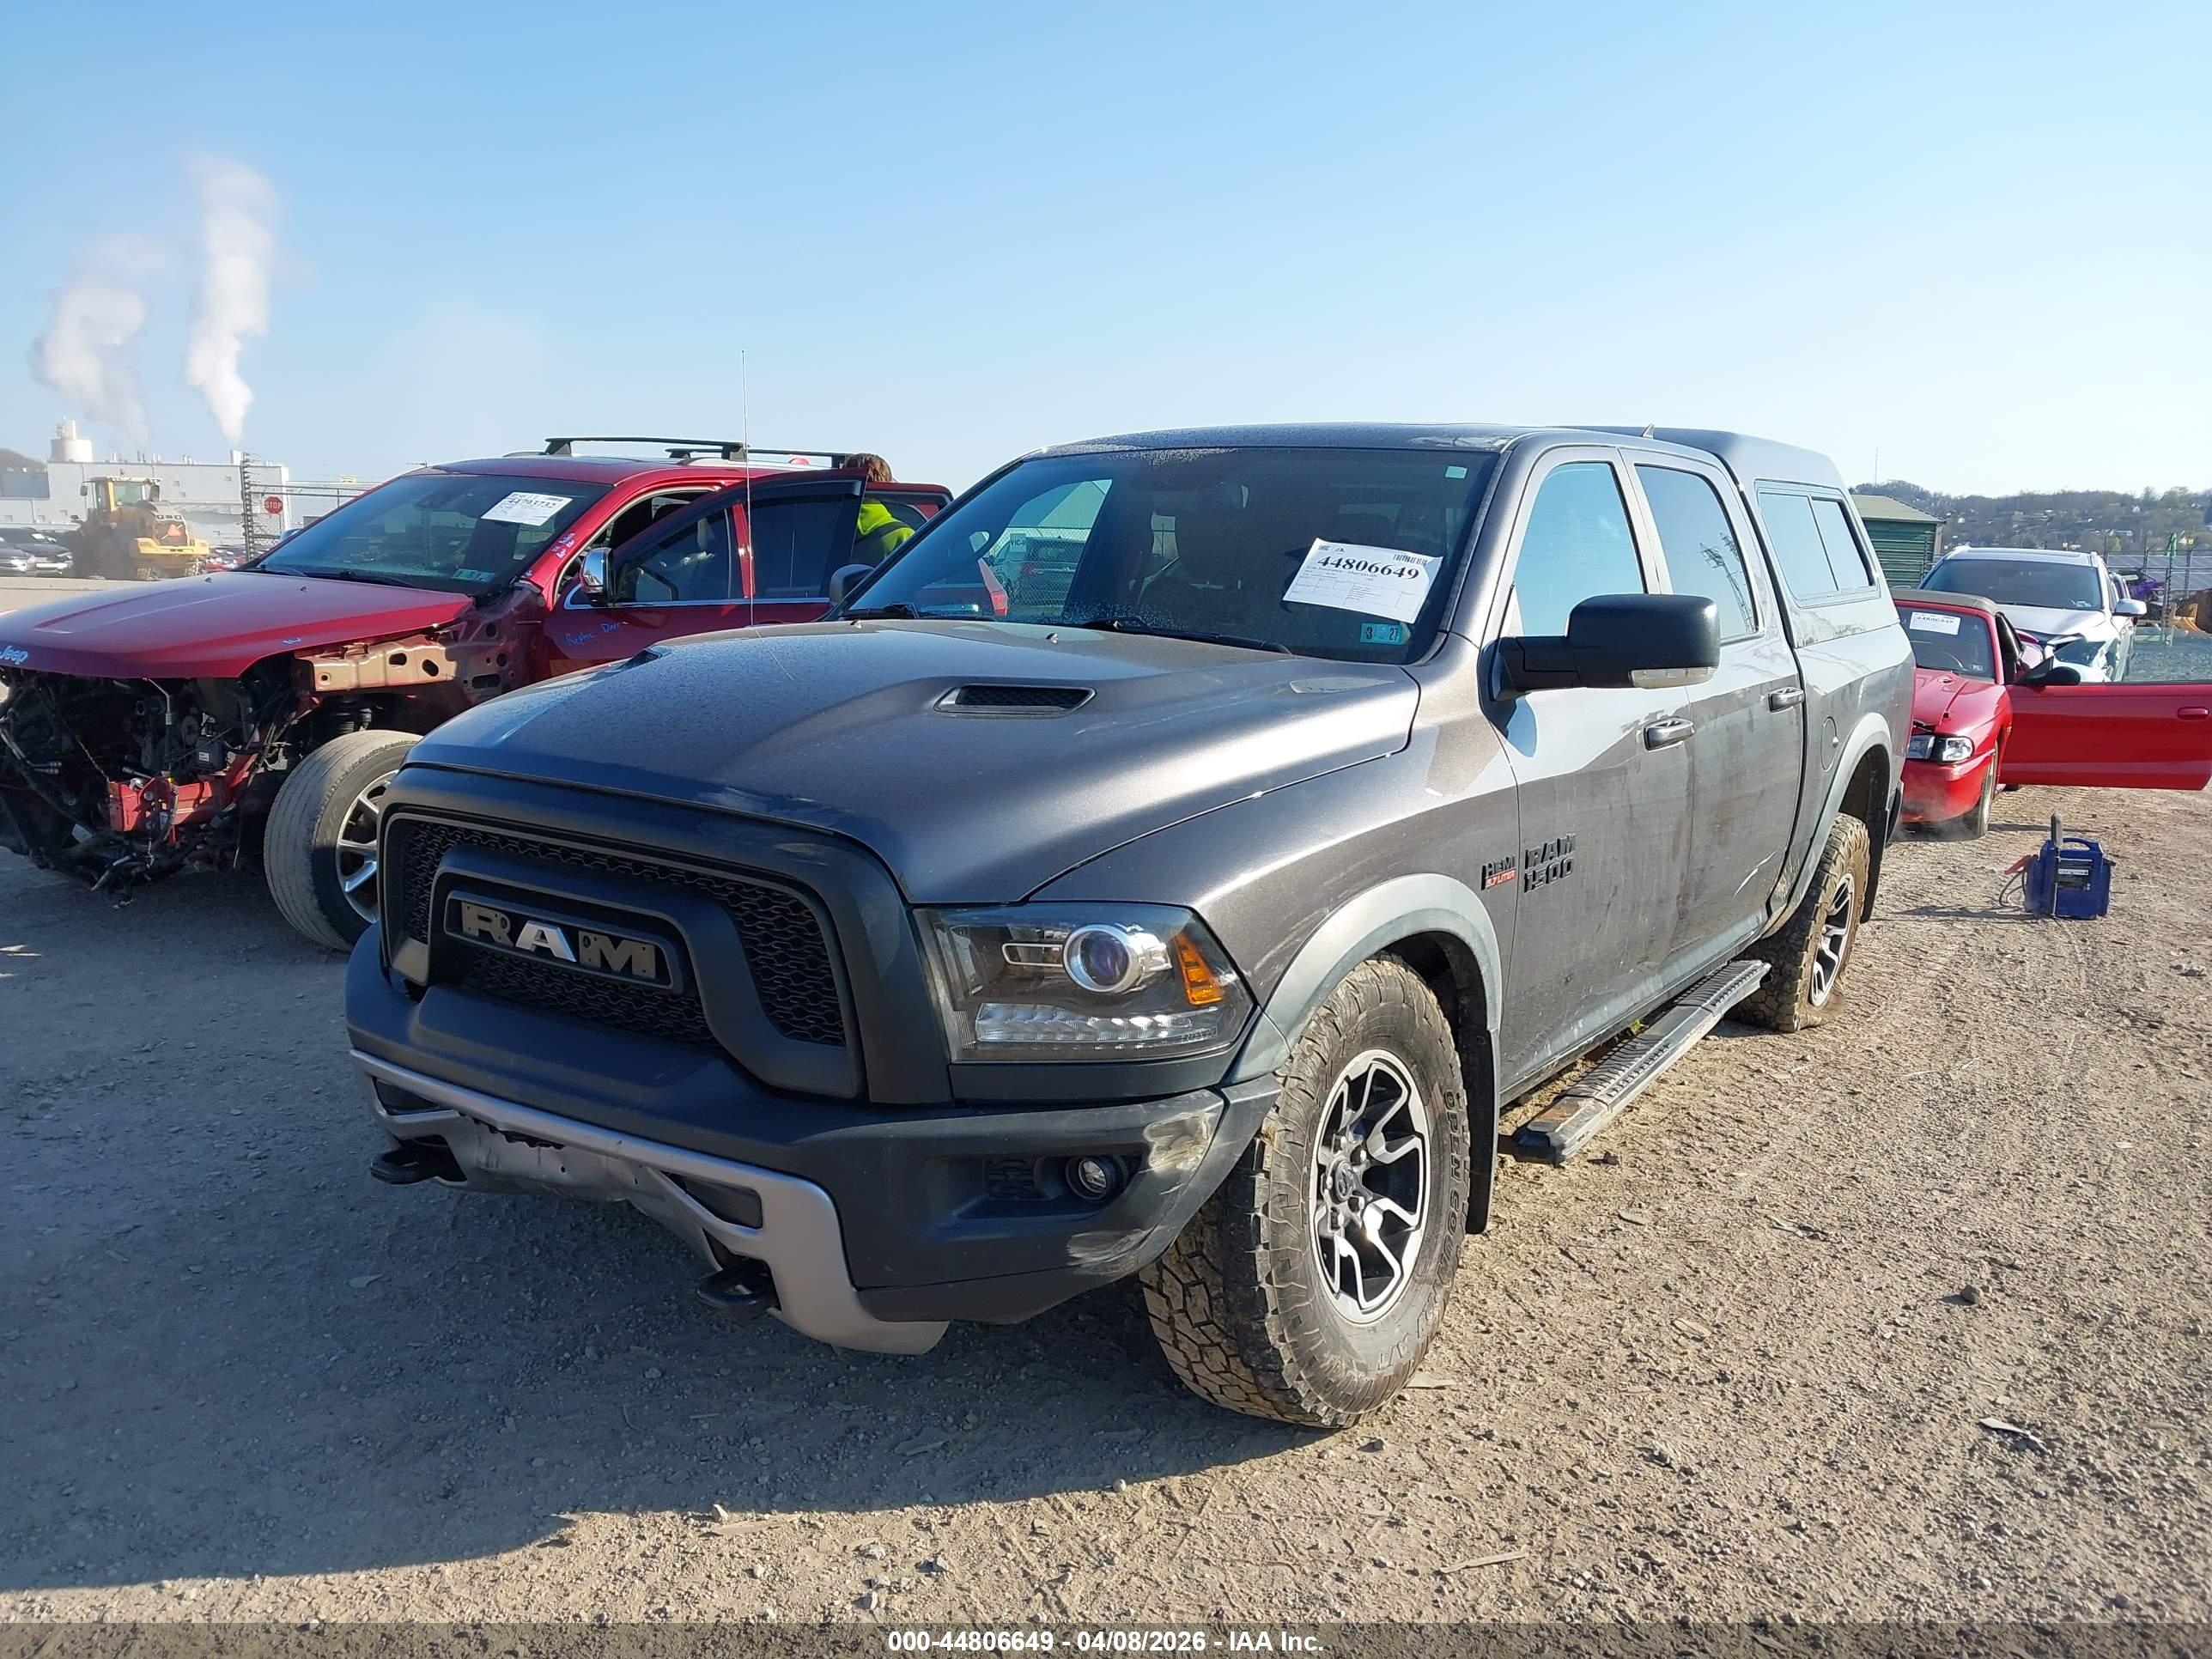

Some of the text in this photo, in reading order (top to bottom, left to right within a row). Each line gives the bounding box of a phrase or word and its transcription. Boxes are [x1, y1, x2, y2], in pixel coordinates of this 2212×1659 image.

[265, 501, 283, 509] STOP
[1317, 556, 1419, 580] 44806649
[1365, 626, 1399, 641] 3 27
[0, 645, 28, 665] Jeep
[1524, 832, 1577, 870] RAM
[1481, 854, 1515, 878] HEMI
[1523, 857, 1575, 893] 1500
[461, 902, 656, 979] RAM
[1443, 1089, 1460, 1181] OPEN
